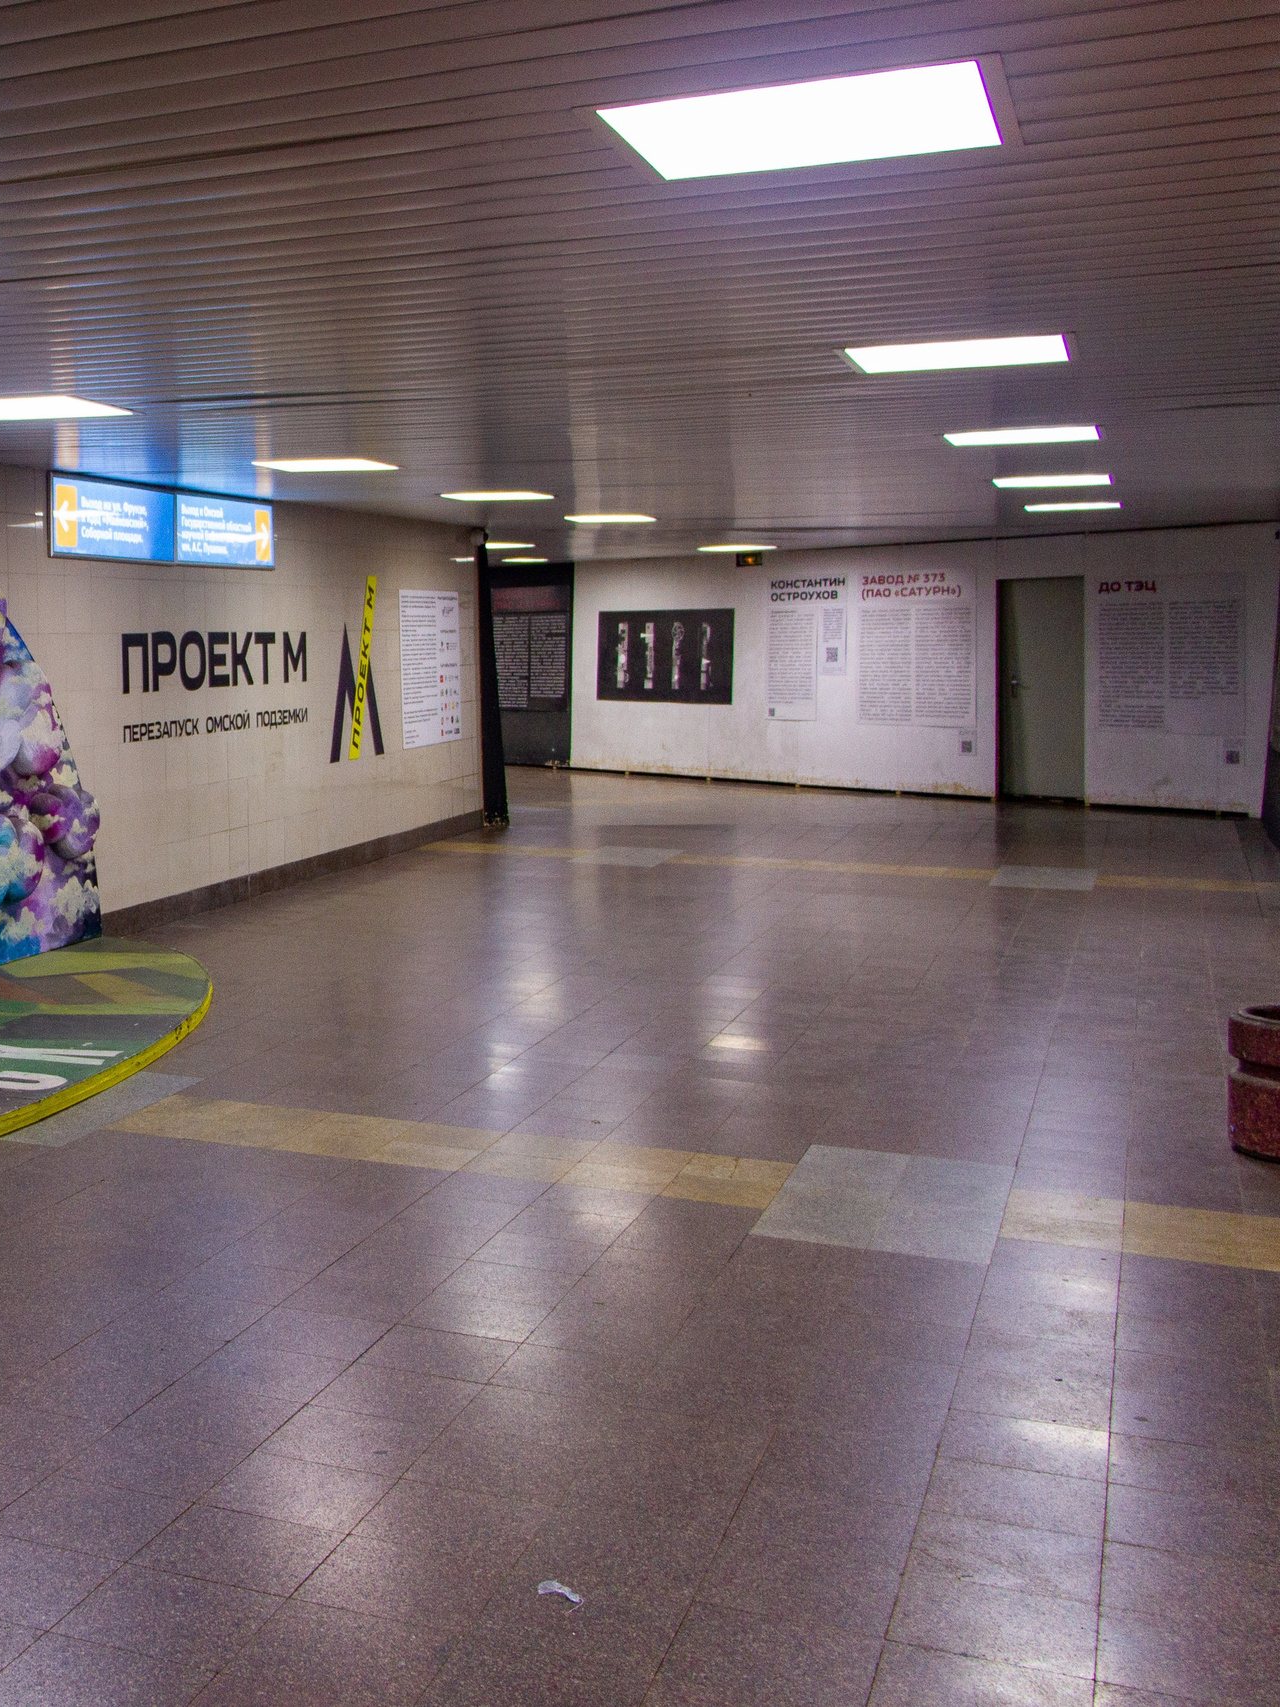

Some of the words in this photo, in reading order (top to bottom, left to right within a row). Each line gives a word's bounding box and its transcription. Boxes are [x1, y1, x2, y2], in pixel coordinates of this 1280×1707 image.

[771, 577, 846, 590] КОНСТАНТИН
[862, 575, 905, 586] ЗАВОД
[907, 574, 920, 584] №
[923, 572, 946, 583] 373
[861, 588, 892, 600] (ПАО
[895, 585, 962, 598] «САТУРН»)
[1098, 581, 1121, 594] ДО
[1125, 580, 1157, 594] ТЭЦ
[771, 590, 838, 602] ОСТРОУХОВ
[121, 631, 276, 694] ПРОЕКТ
[283, 631, 308, 684] М
[351, 617, 372, 749] ПРОЕКТ
[367, 584, 375, 610] М
[123, 718, 200, 743] ПЕРЕЗАПУСК
[206, 710, 251, 734] ОМСКОЙ
[256, 707, 309, 730] ПОДЗЕМКИ
